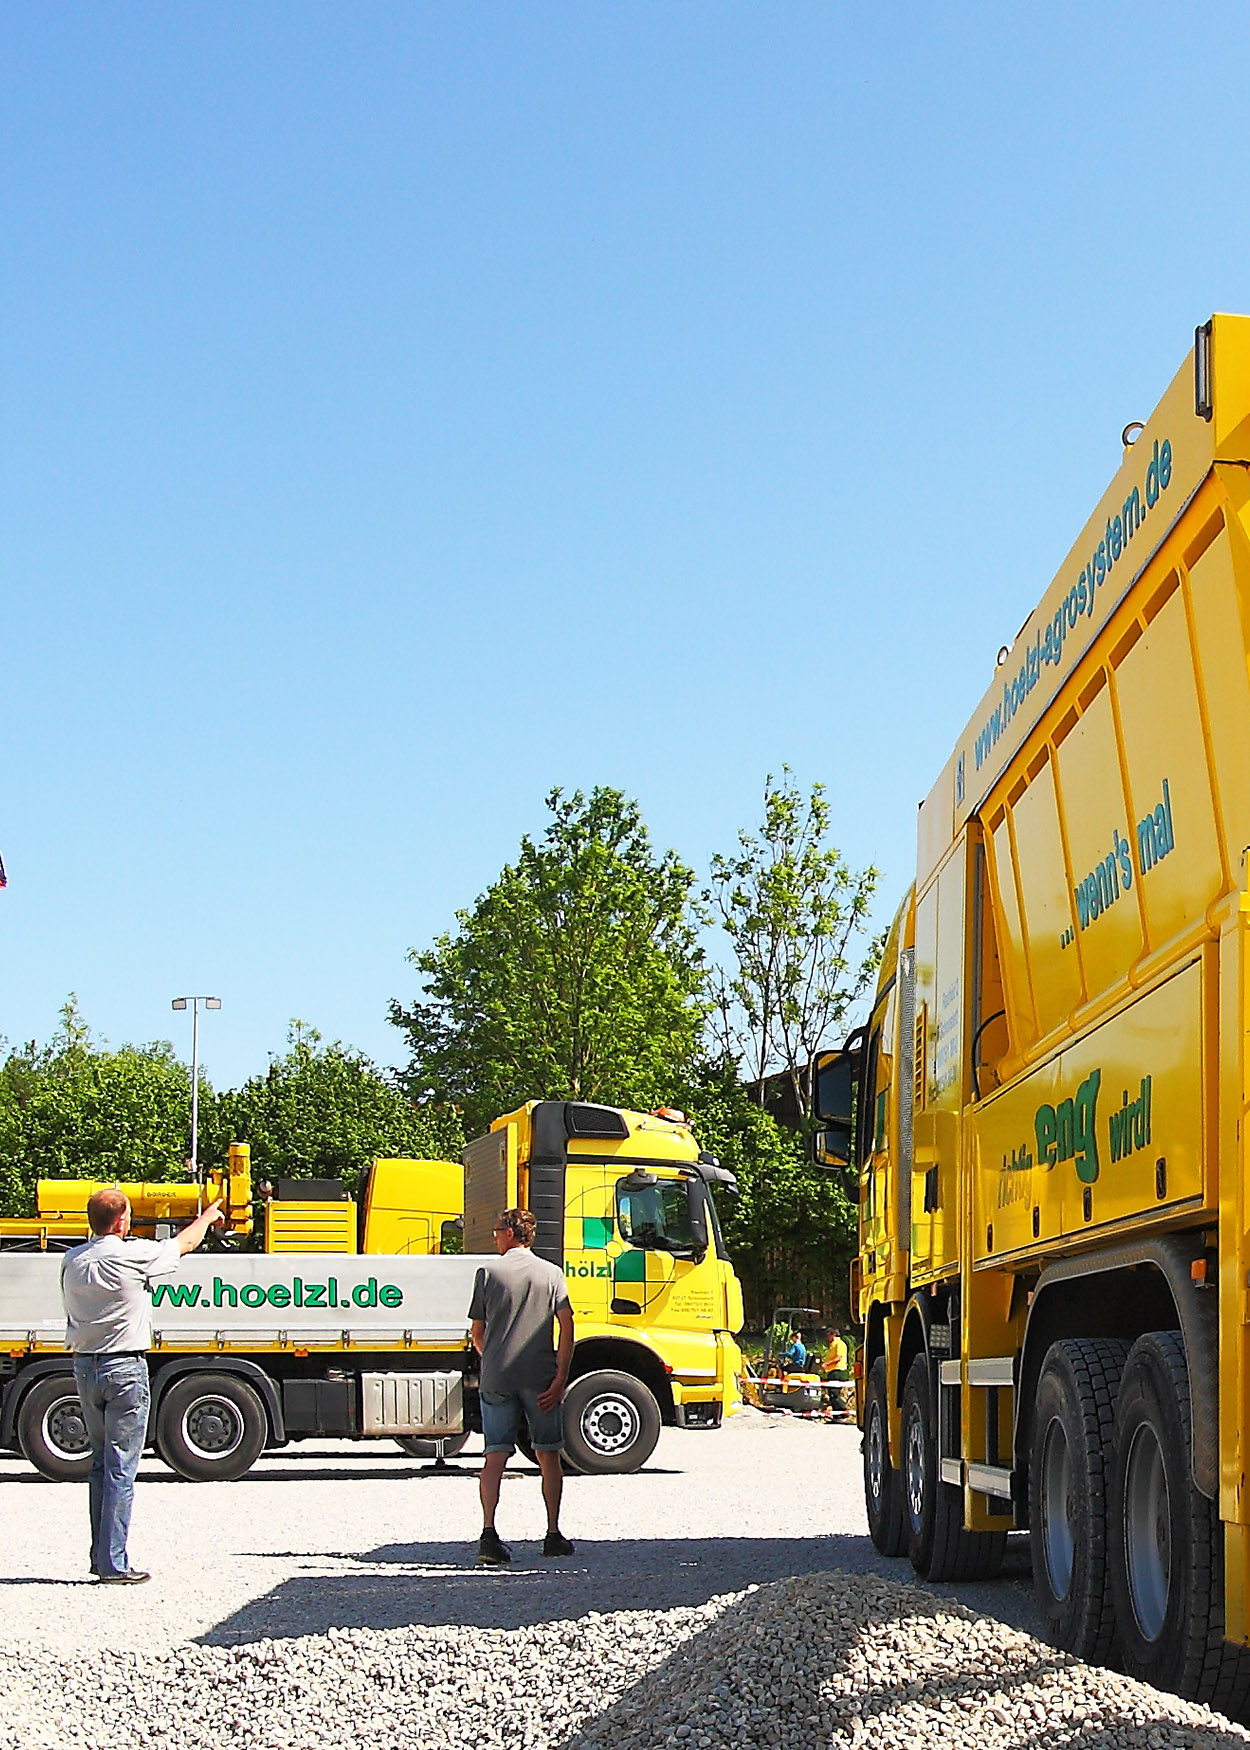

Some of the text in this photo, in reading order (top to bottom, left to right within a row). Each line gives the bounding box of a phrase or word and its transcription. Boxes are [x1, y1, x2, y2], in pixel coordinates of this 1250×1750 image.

[974, 438, 1172, 771] www.hoelzl-agrosystem.de
[1137, 778, 1174, 876] mal
[1035, 1068, 1101, 1184] eng
[1109, 1074, 1152, 1164] wird!
[151, 1277, 404, 1308] w.hoelzl.de
[565, 1261, 612, 1278] hölzl
